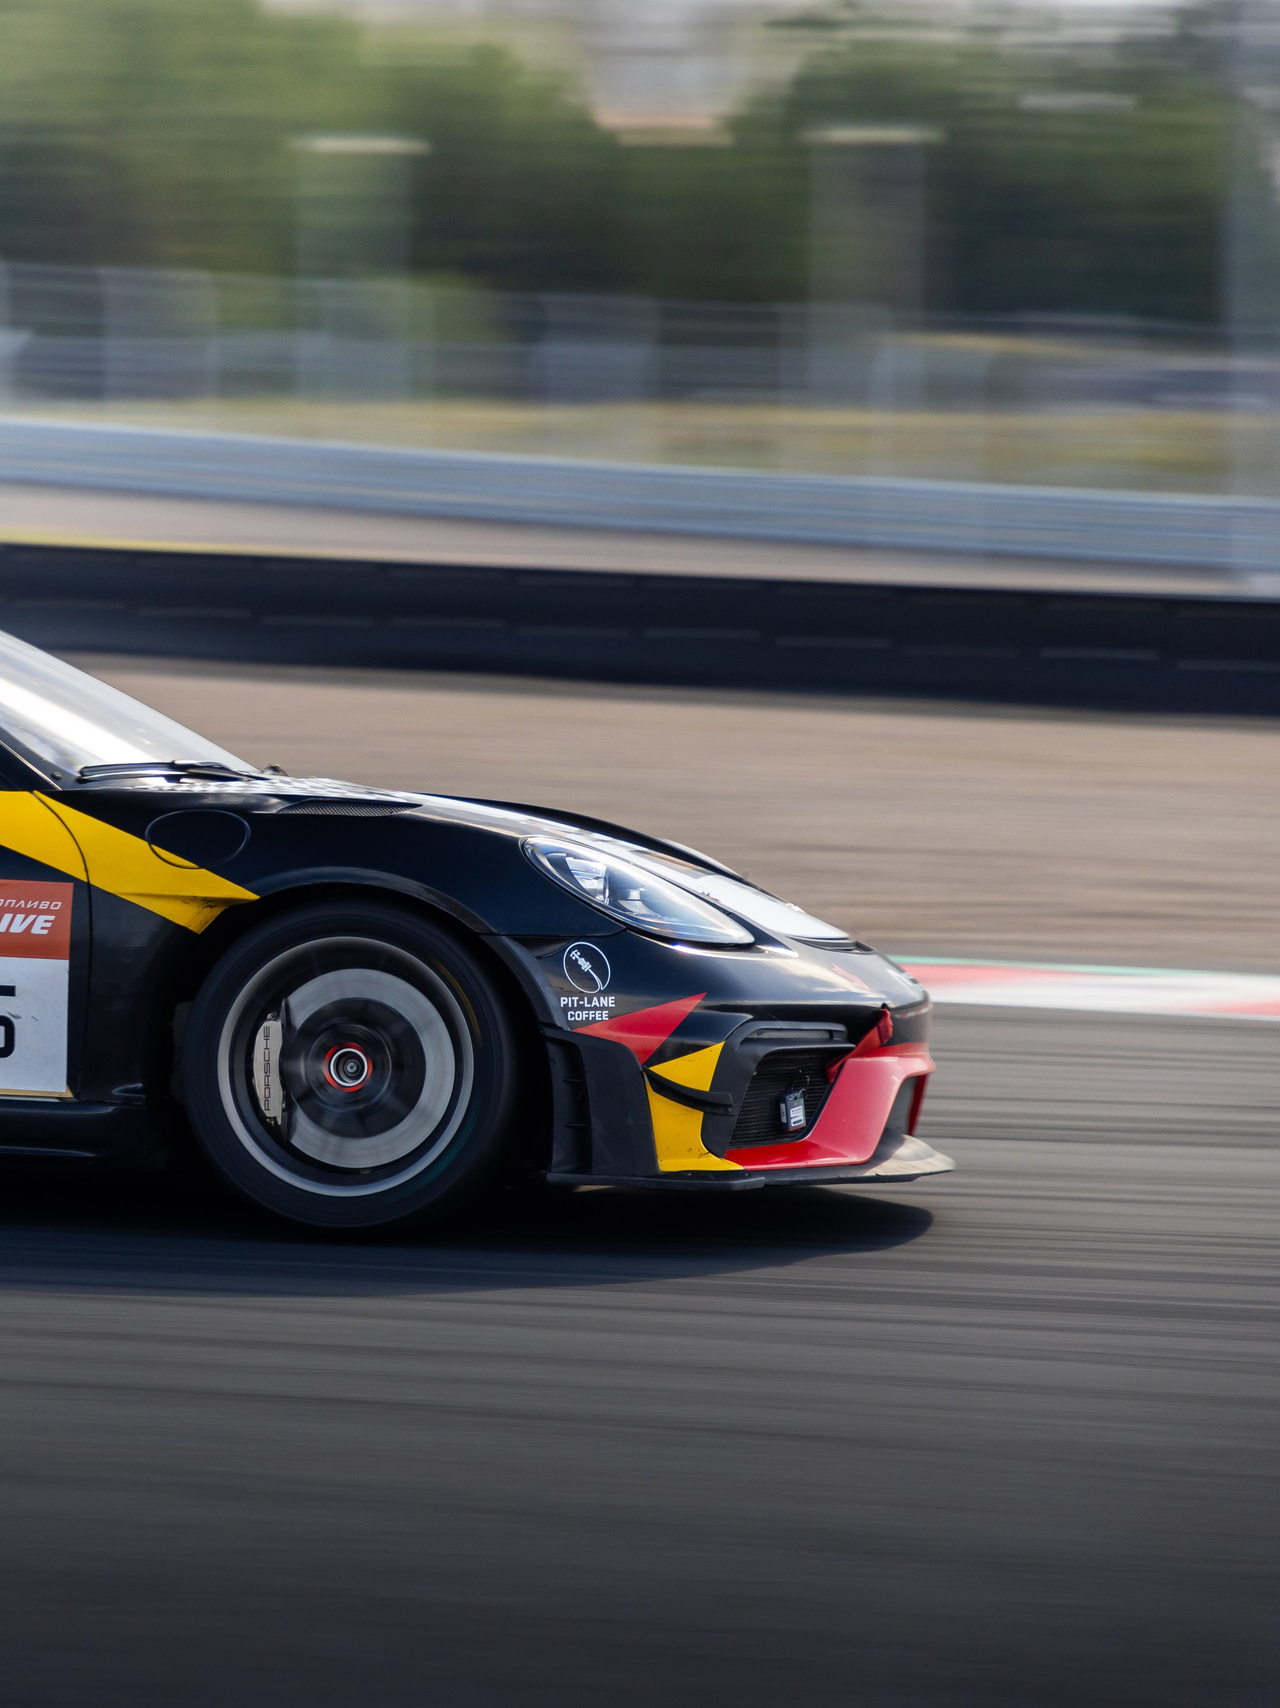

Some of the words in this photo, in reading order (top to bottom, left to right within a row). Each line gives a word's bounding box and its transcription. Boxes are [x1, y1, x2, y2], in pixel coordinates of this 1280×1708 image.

[560, 996, 616, 1008] PIT-LANE
[567, 1011, 609, 1021] COFFEE
[263, 1025, 271, 1111] PORSCHE
